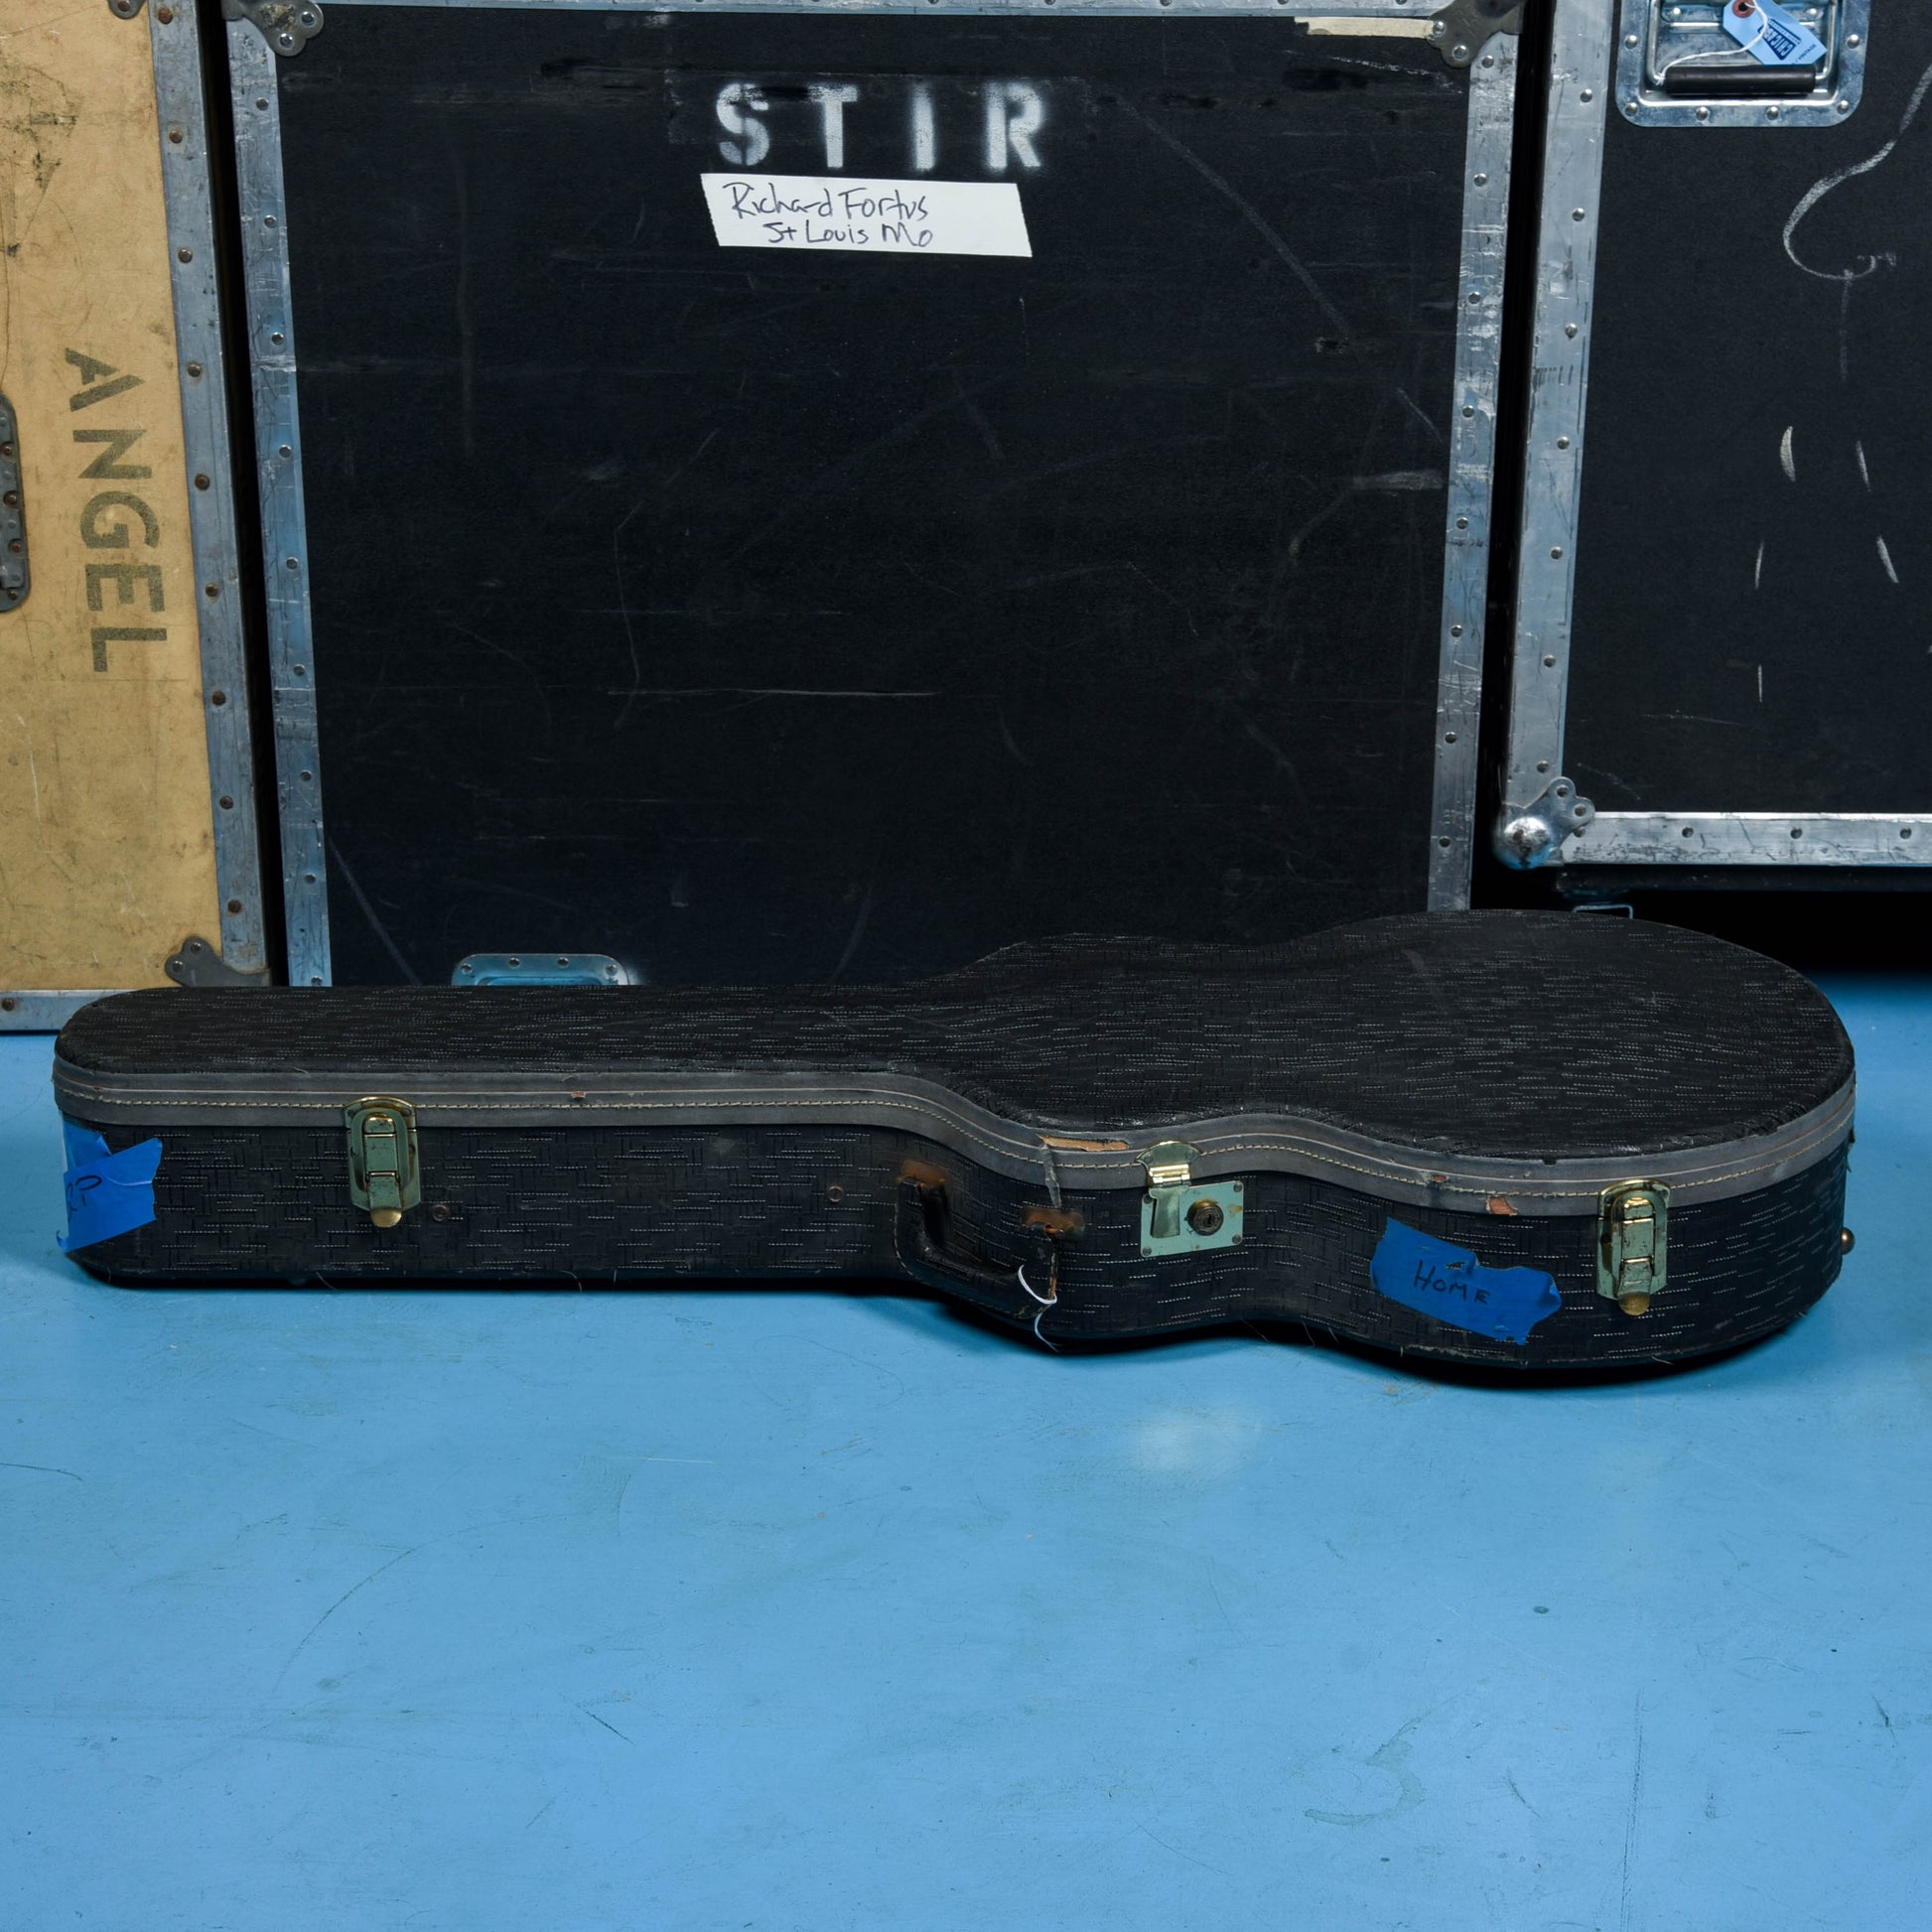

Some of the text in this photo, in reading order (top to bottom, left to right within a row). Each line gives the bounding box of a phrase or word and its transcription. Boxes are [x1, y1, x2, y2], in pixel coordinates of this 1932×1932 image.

[715, 81, 1043, 170] STIR
[722, 182, 834, 219] Richard
[762, 222, 798, 243] St
[805, 219, 869, 243] Louis
[65, 347, 168, 672] ANGEL
